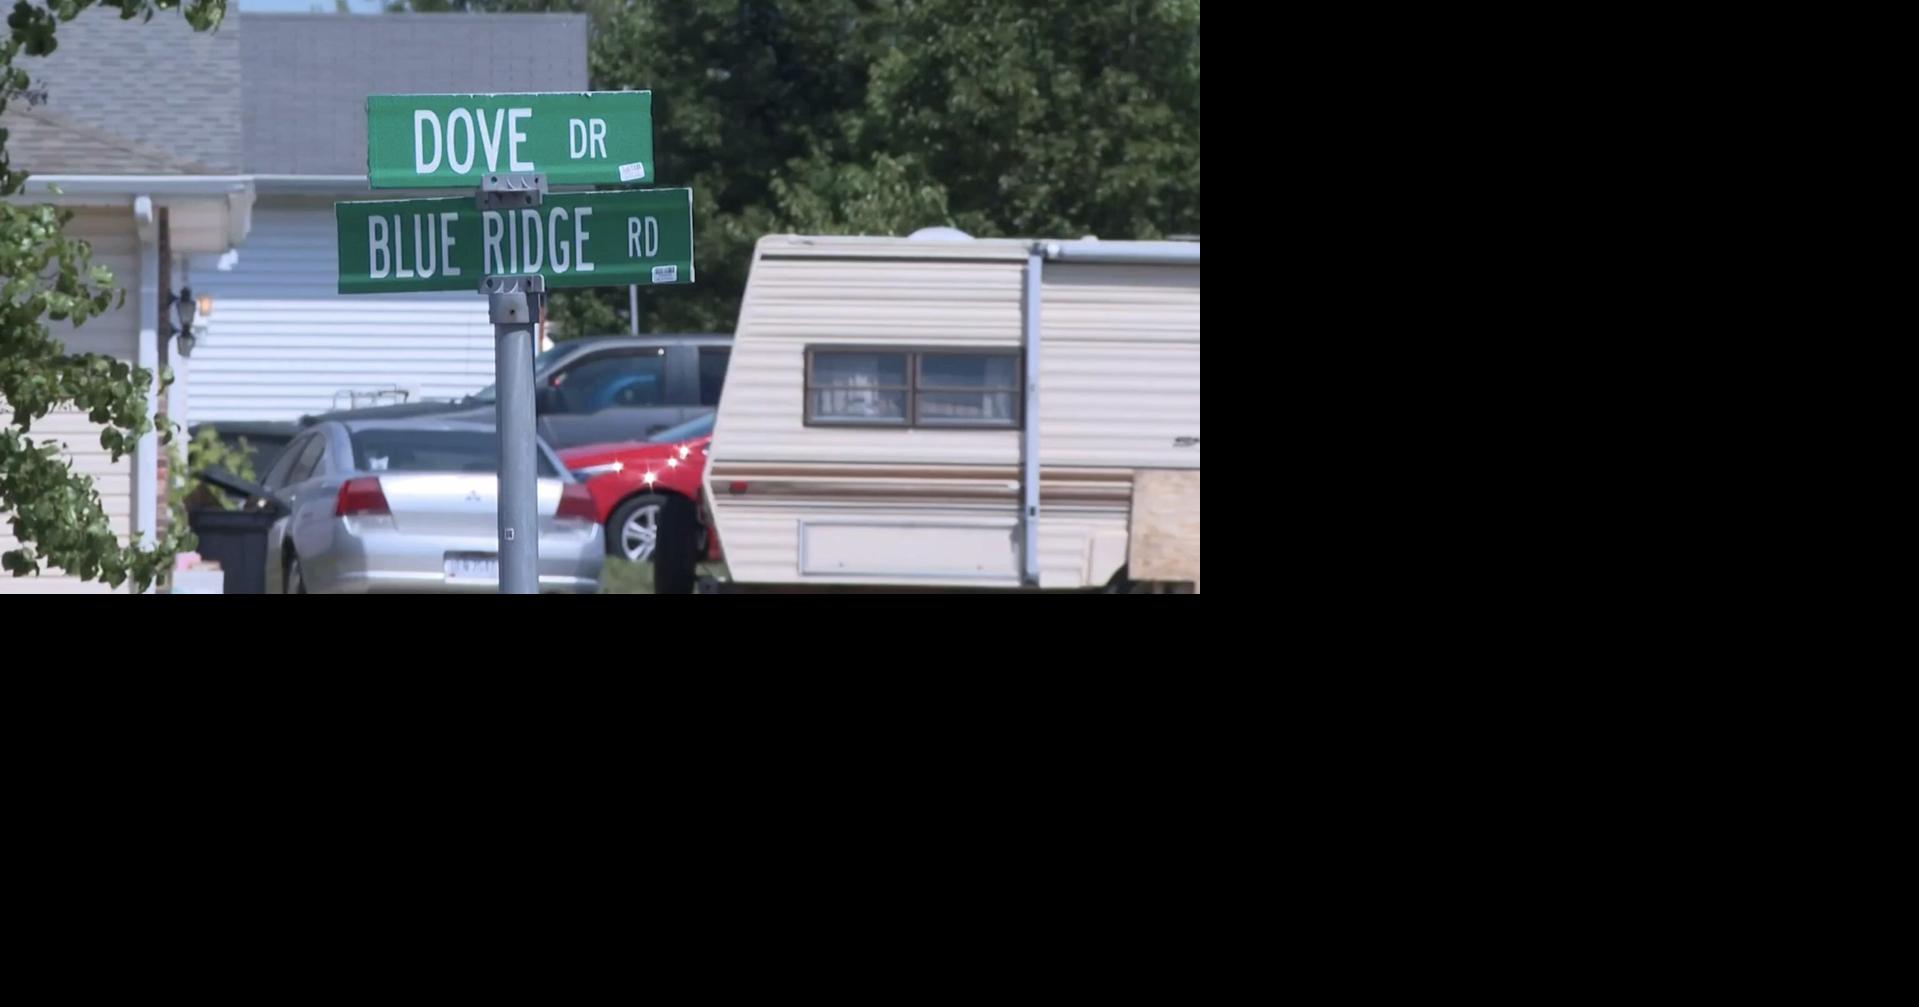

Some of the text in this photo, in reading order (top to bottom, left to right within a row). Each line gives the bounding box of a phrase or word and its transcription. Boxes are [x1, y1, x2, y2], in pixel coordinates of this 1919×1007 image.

[414, 107, 607, 175] DOVE DR
[368, 206, 659, 279] BLUE RIDGE RD
